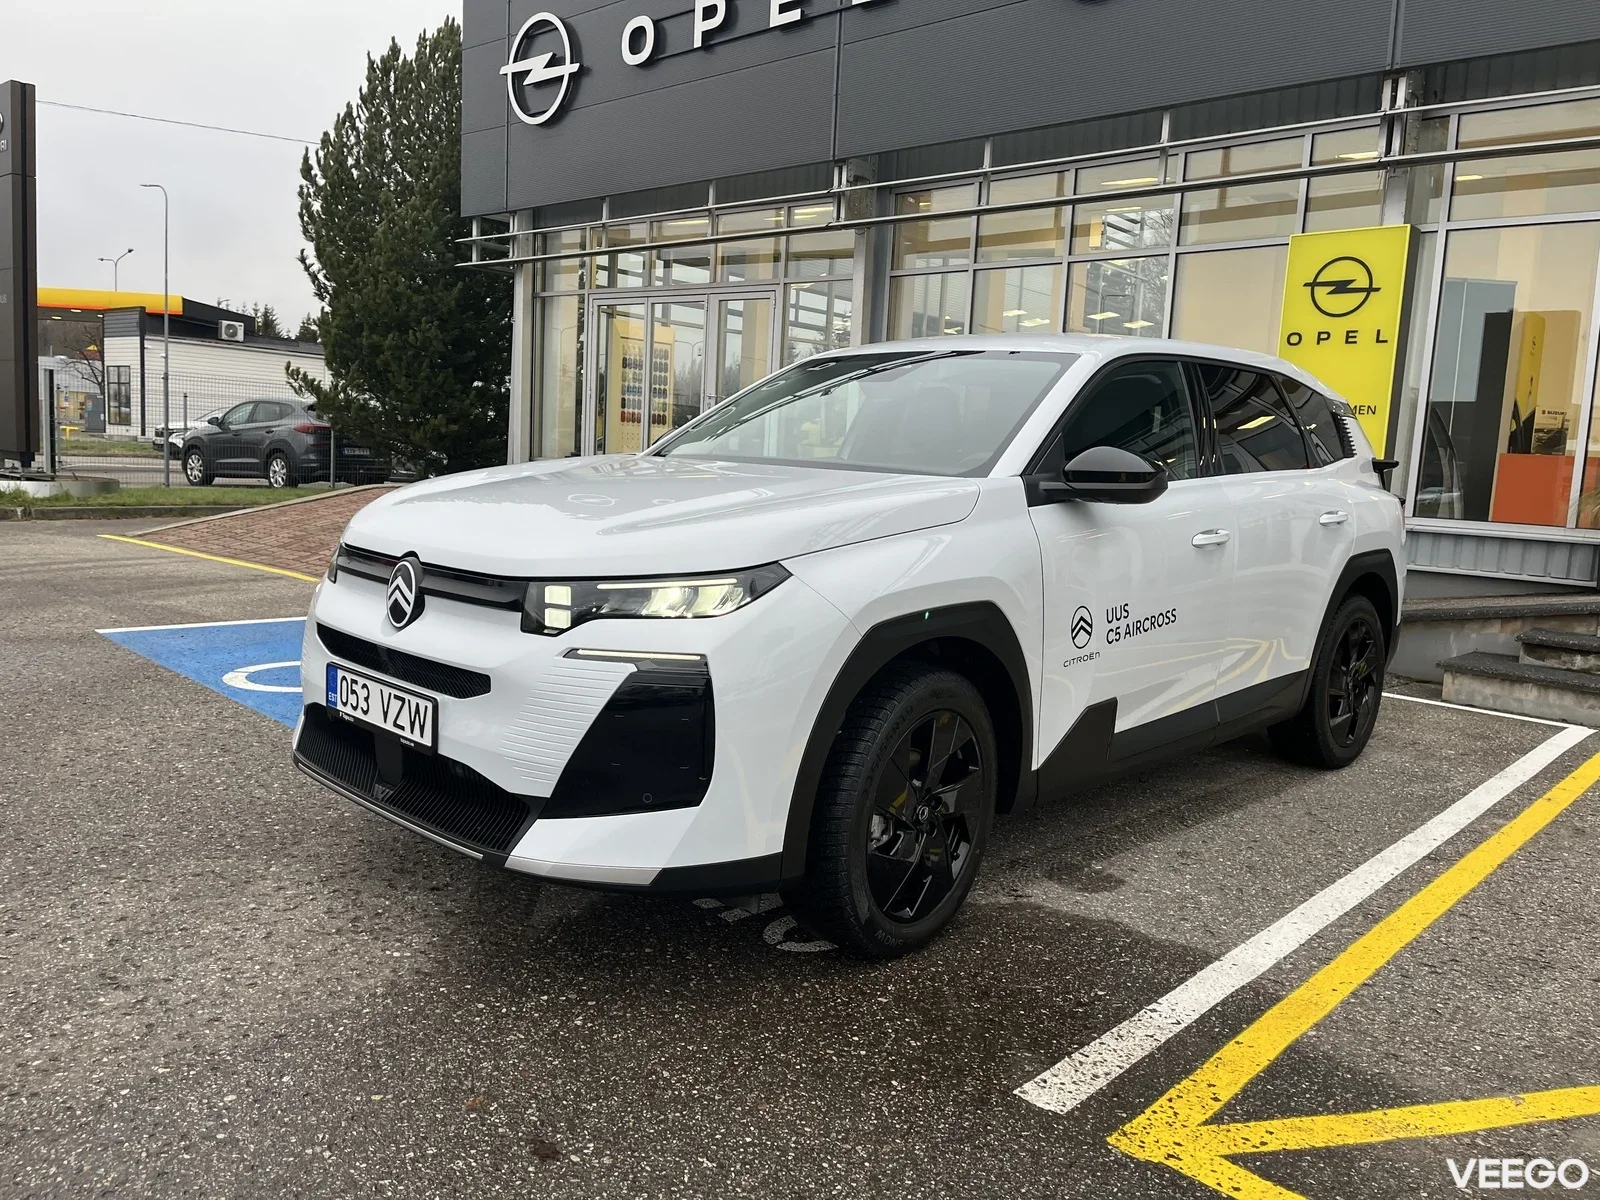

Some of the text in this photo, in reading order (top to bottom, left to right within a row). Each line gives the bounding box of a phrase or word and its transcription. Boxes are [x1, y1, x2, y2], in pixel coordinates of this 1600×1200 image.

[1286, 328, 1389, 346] OPEL
[1106, 603, 1130, 624] UUS
[1106, 608, 1177, 645] C5 AIRCROSS
[328, 692, 337, 703] EST
[340, 675, 428, 739] 053 VZW
